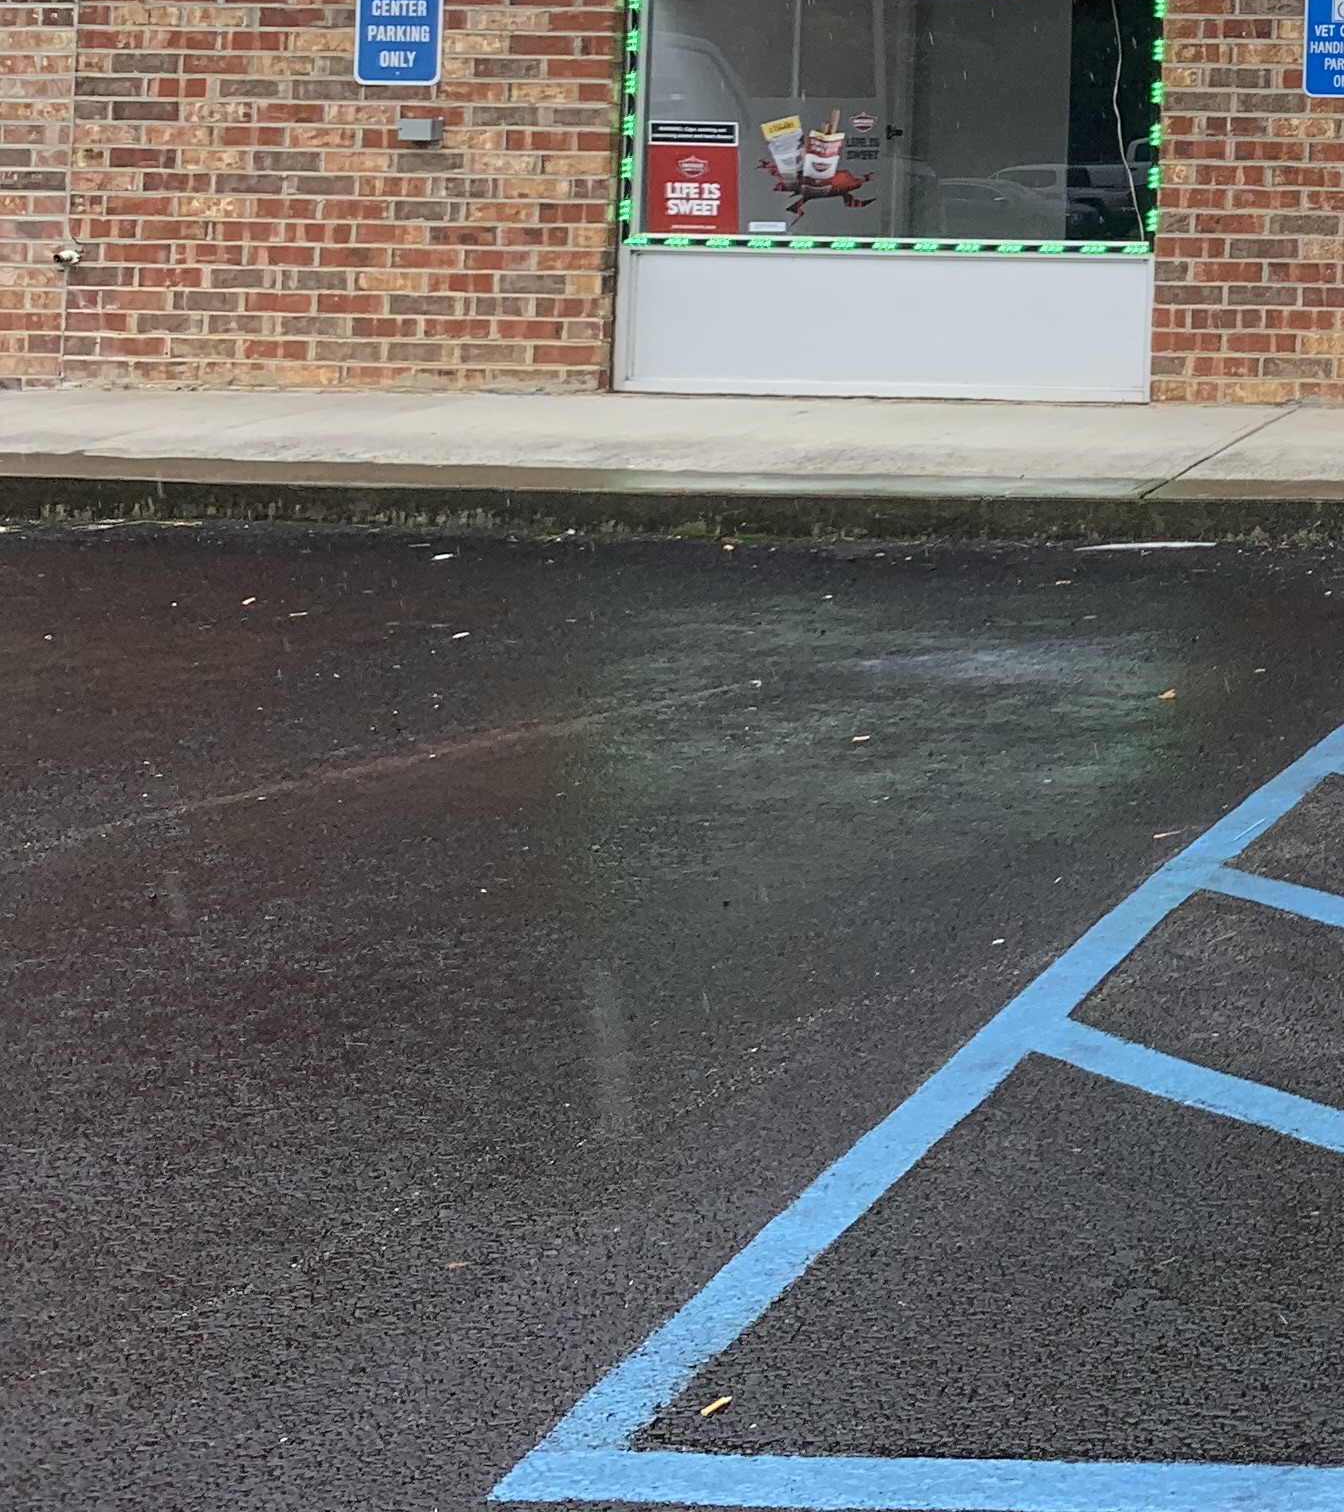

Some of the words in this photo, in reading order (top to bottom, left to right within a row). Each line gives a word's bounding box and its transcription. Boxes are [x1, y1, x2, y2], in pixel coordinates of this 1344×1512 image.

[371, 0, 428, 17] CENTER
[367, 25, 431, 43] PARKING
[1314, 24, 1334, 37] VET
[379, 50, 417, 68] ONLY
[665, 181, 700, 199] LIFE
[701, 182, 721, 199] IS
[666, 198, 721, 217] SWEET
